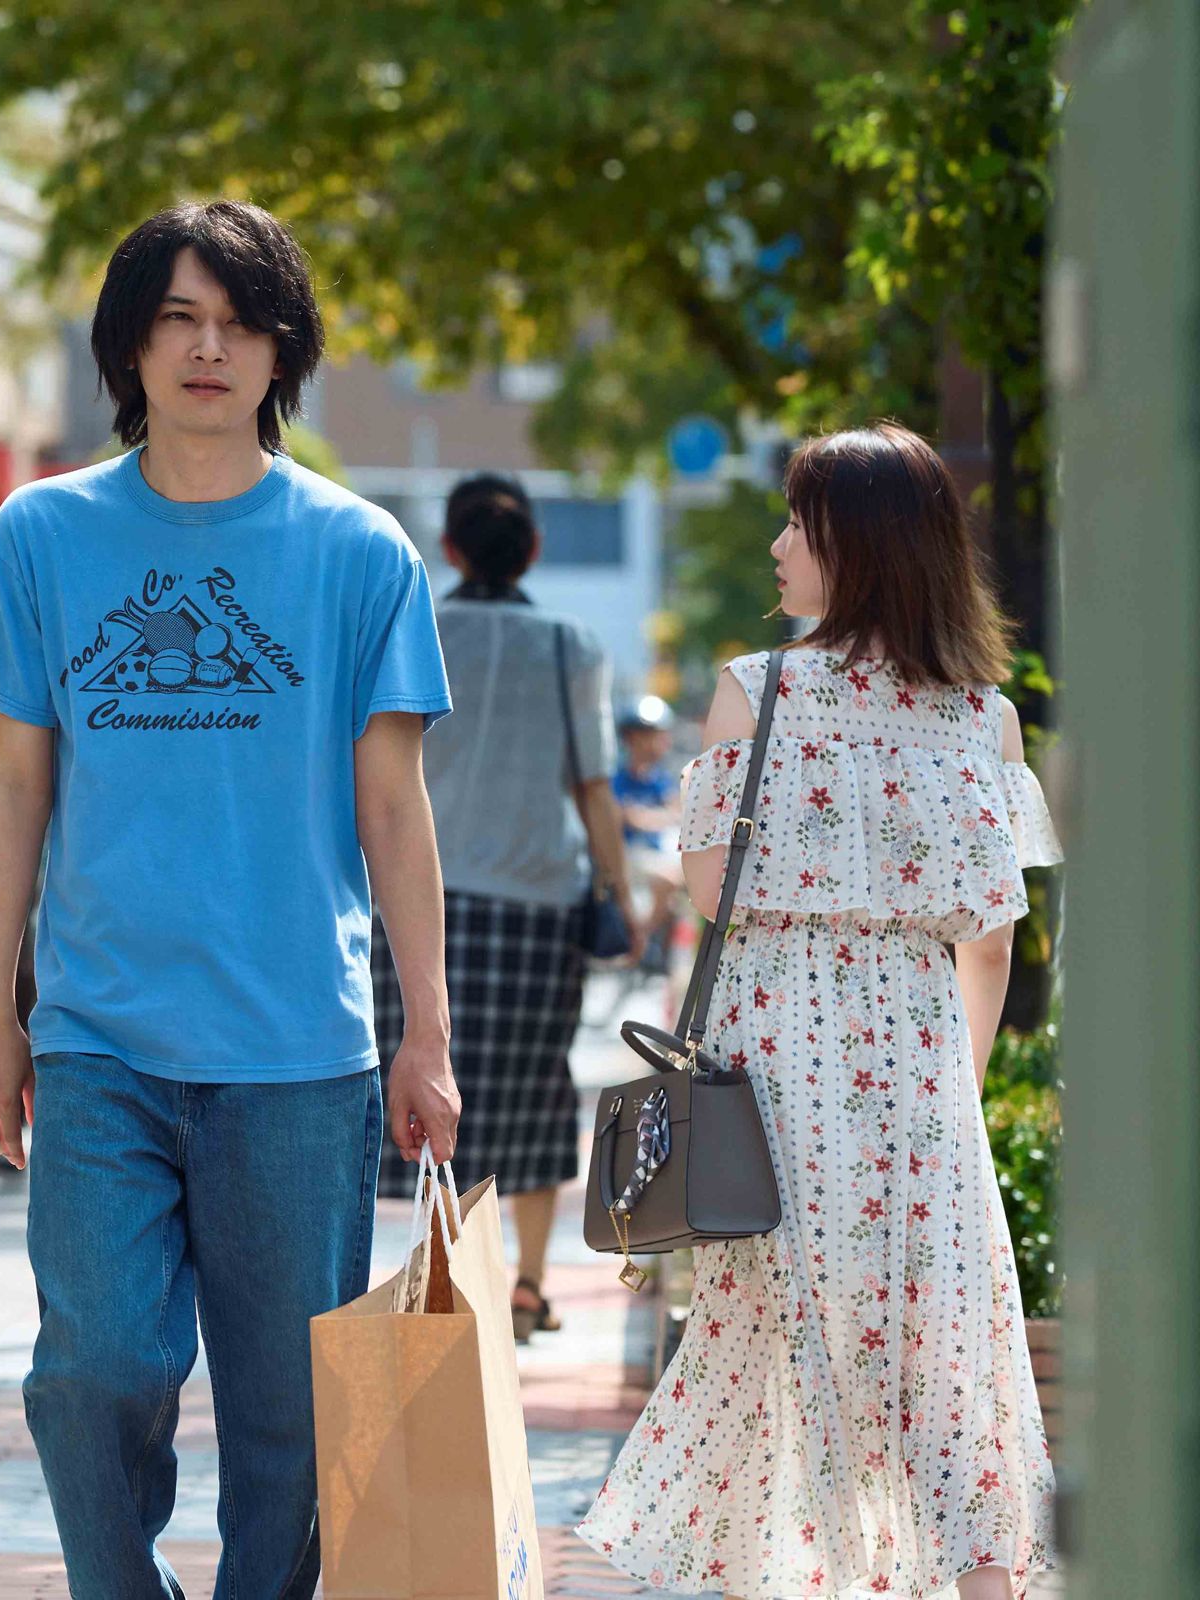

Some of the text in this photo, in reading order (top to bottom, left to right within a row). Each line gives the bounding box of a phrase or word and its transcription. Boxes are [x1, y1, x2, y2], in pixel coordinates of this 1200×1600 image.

[59, 622, 111, 689] ood
[196, 566, 306, 687] Recreation
[87, 698, 262, 731] Commission
